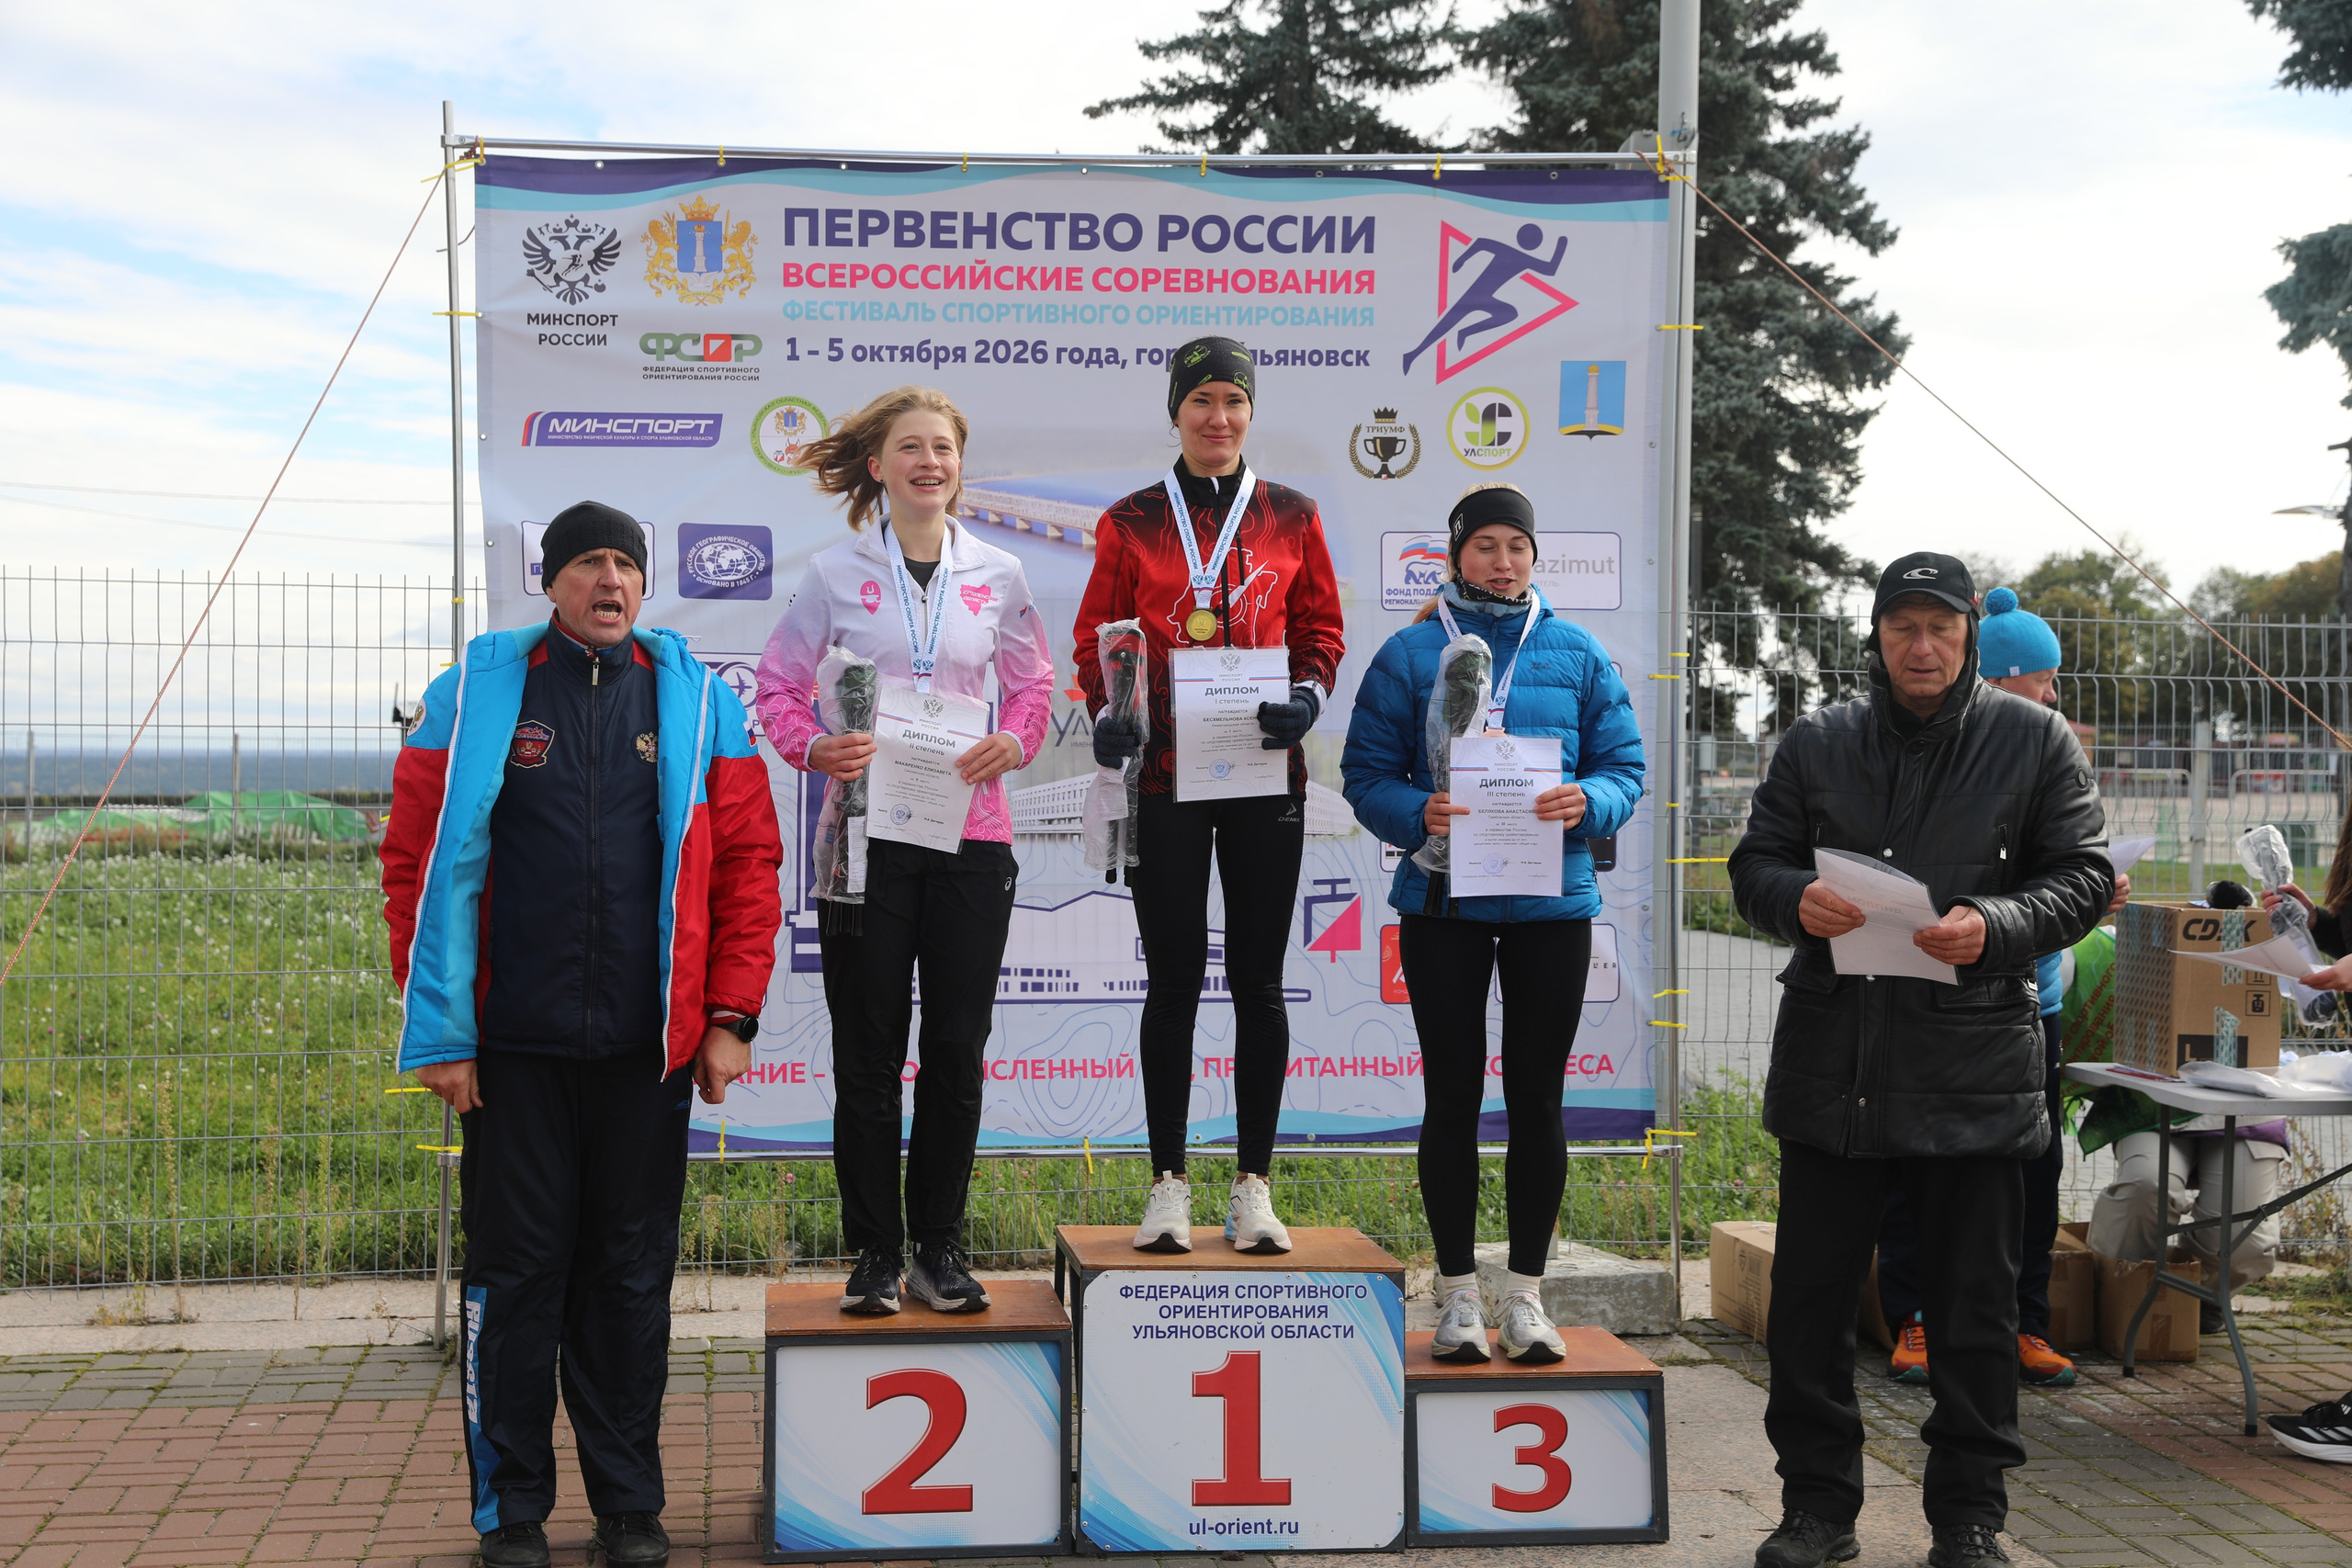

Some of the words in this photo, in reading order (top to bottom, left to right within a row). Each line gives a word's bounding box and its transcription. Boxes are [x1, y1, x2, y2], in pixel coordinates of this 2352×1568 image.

[784, 207, 1143, 254] ПЕРВЕНСТВО
[1157, 214, 1375, 254] РОССИИ
[783, 259, 1083, 293] ВСЕРОССИЙСКИЕ
[1091, 267, 1375, 295] СОРЕВНОВАНИЯ
[526, 313, 618, 327] МИНСПОРТ
[782, 299, 935, 323] ФЕСТИВАЛЬ
[942, 301, 1131, 325] СПОРТИВНОГО
[1136, 304, 1374, 327] ОРИЕНТИРОВАНИЯ
[538, 333, 607, 346] РОССИИ
[786, 337, 799, 361] 1
[828, 338, 843, 362] 5
[851, 338, 966, 370] октября
[974, 339, 1048, 364] 2026
[1056, 347, 1127, 369] года,
[1136, 348, 1176, 372] гор
[548, 418, 714, 434] МИНСПОРТ
[1365, 425, 1406, 434] ТРИУМФ
[1464, 447, 1512, 457] УЛСПОРТ
[686, 546, 697, 574] РУССКОЕ
[695, 536, 750, 549] ГЕОГРАФИЧЕСКОЕ
[749, 544, 766, 571] ОБЩЕСТВО
[1533, 555, 1614, 574] azimut
[695, 576, 729, 588] ОСНОВАНО
[736, 578, 751, 587] 1845
[1385, 588, 1411, 596] ФОНД
[1204, 686, 1259, 696] ДИПЛОМ
[902, 728, 956, 749] ДИПЛОМ
[915, 744, 945, 756] степень
[895, 760, 924, 771] МАКАРЕНКО
[923, 766, 952, 776] ЕЛИЗАВЕТА
[1479, 778, 1534, 788] ДИПЛОМ
[2182, 918, 2257, 942] CDK
[1119, 1285, 1229, 1301] ФЕДЕРАЦИЯ
[1234, 1285, 1367, 1299] СПОРТИВНОГО
[1159, 1304, 1329, 1319] ОРИЕНТИРОВАНИЯ
[1132, 1321, 1265, 1339] УЛЬЯНОВСКОЙ
[1271, 1325, 1354, 1339] ОБЛАСТИ
[1192, 1350, 1292, 1506] 1
[862, 1368, 974, 1516] 2
[1492, 1403, 1572, 1513] 3
[1189, 1517, 1299, 1535] ul-orient.ru
